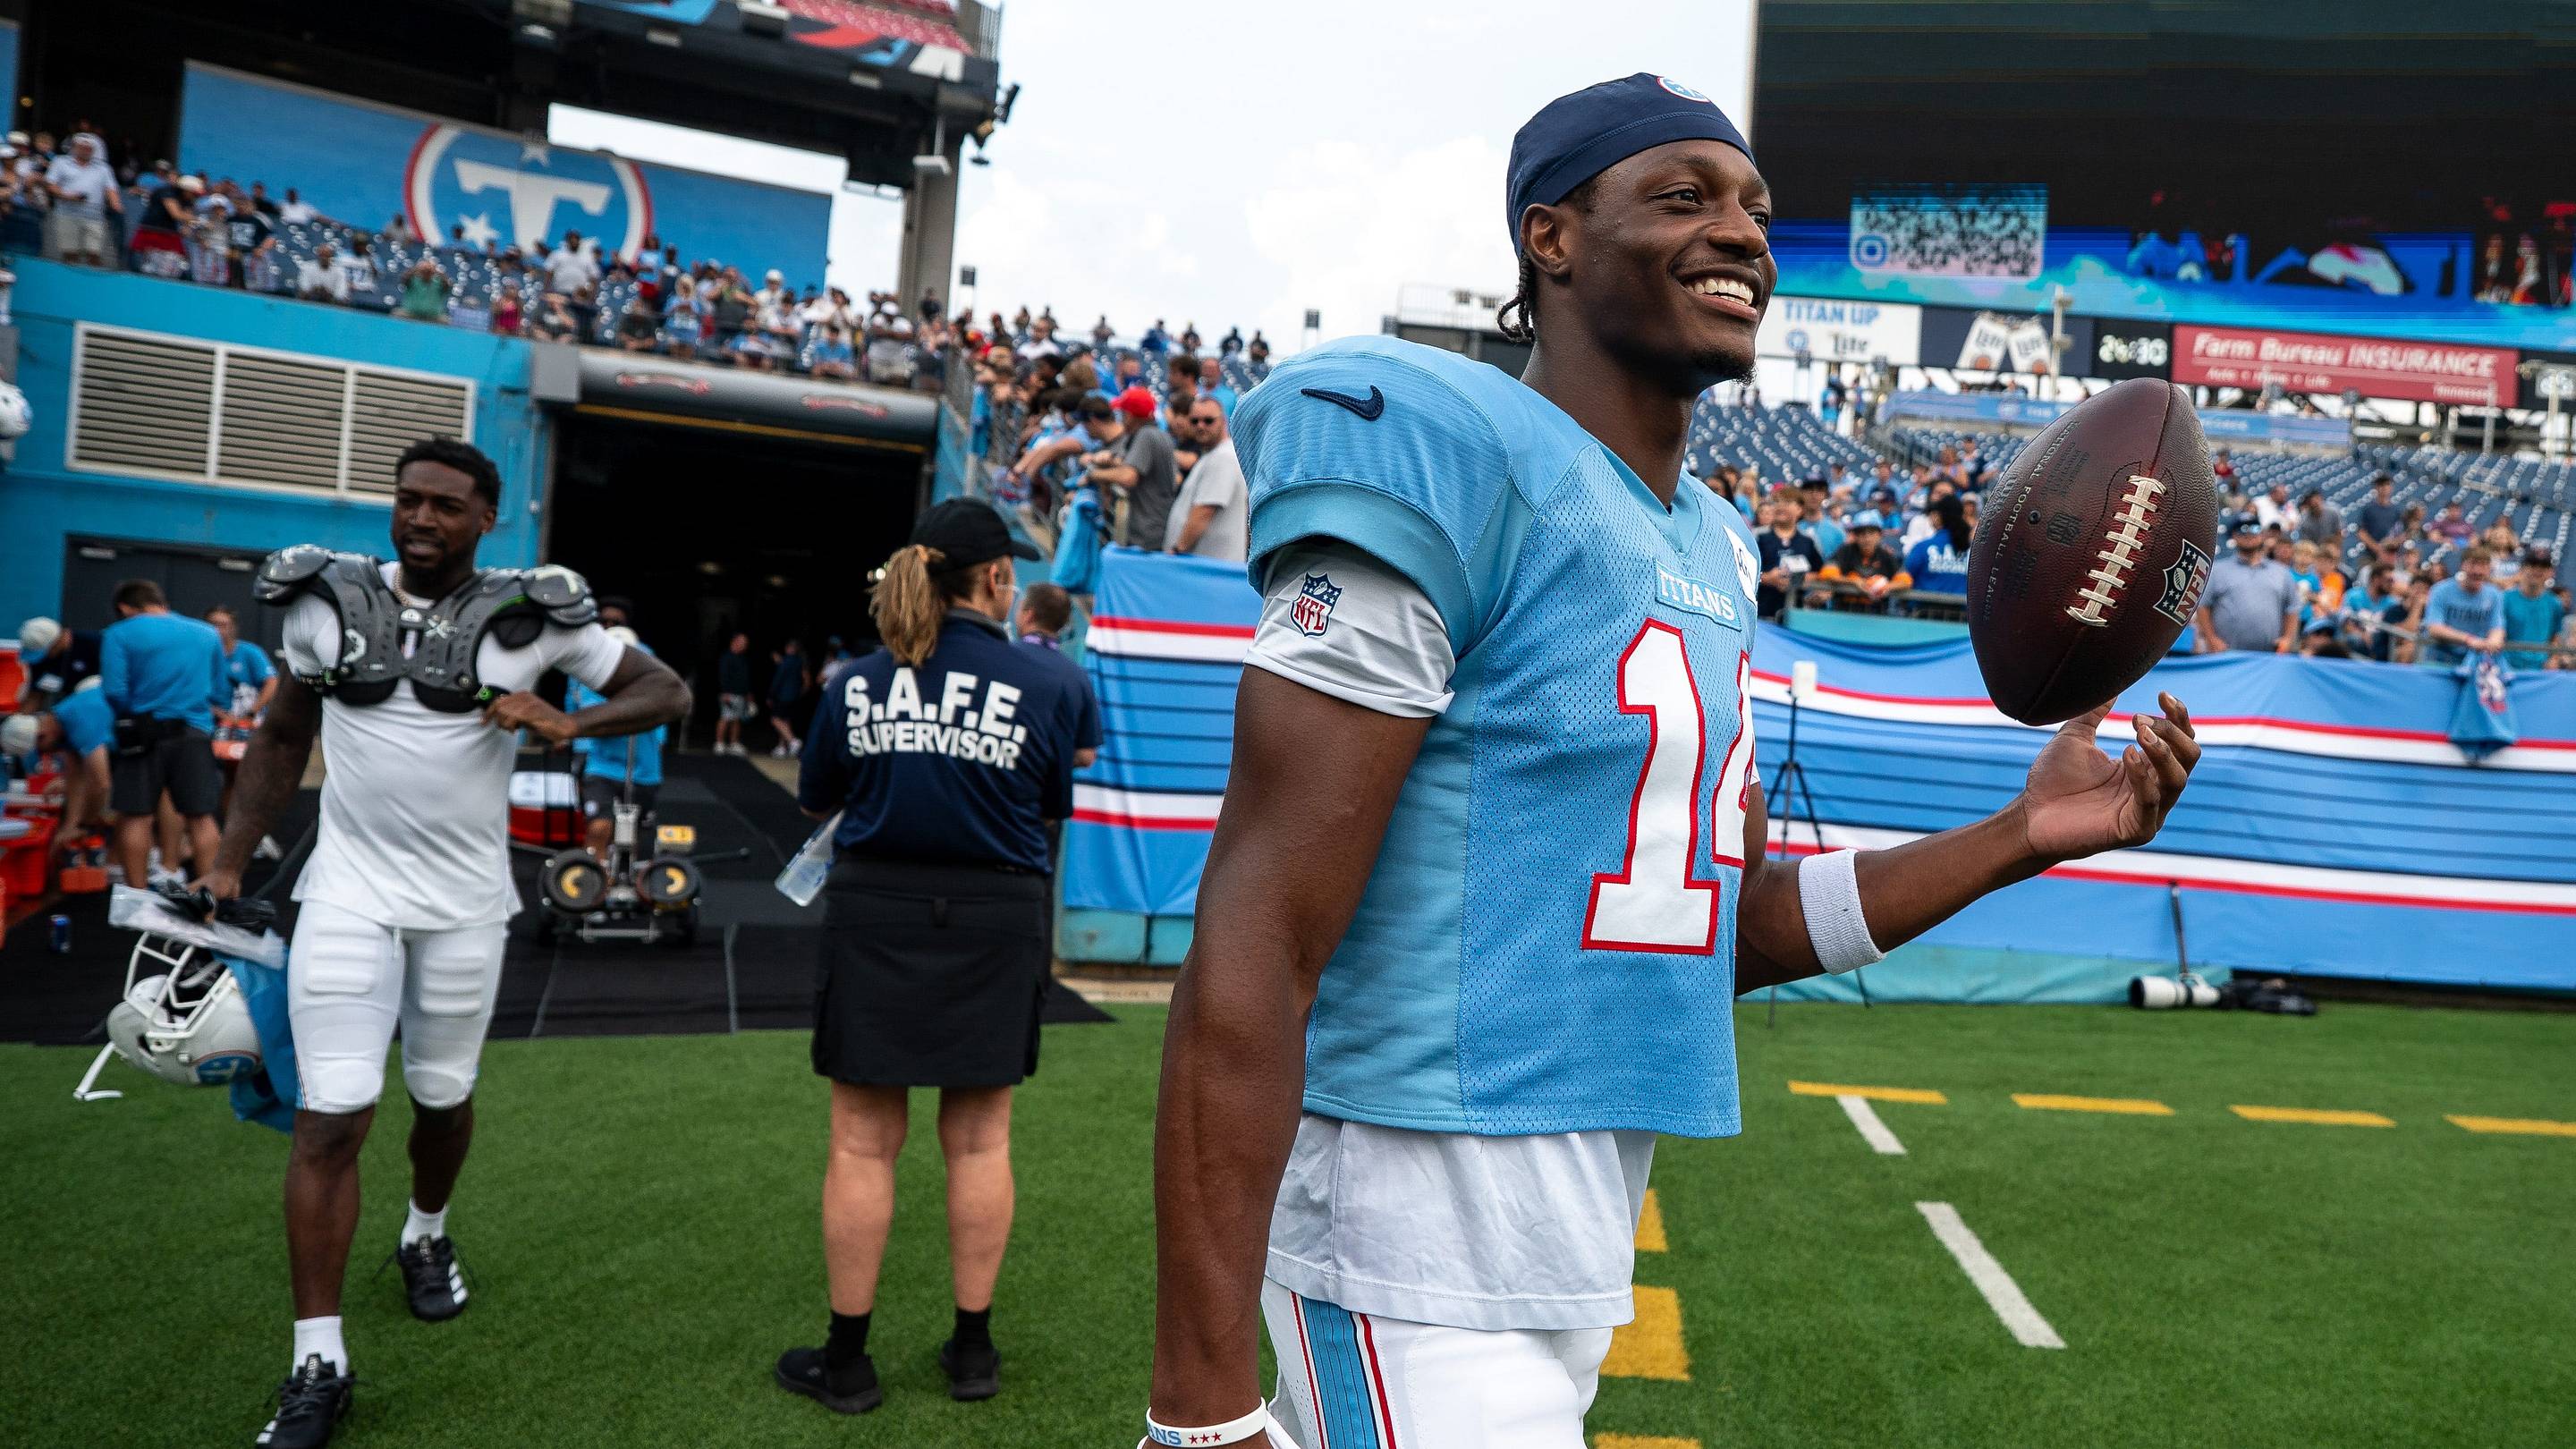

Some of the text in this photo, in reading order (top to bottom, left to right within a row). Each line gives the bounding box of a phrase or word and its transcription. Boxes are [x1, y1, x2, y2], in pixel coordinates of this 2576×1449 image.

[1783, 299, 1879, 326] TITAN UP
[2194, 332, 2498, 377] Farm Bureau INSURANCE
[1995, 486, 2033, 559] FOOTBALL
[1293, 596, 1326, 631] NFL
[1657, 569, 1735, 621] TITANS
[2175, 564, 2209, 617] NFL
[845, 666, 1027, 744] S.A.F.E.
[848, 721, 1021, 770] SUPERVISOR
